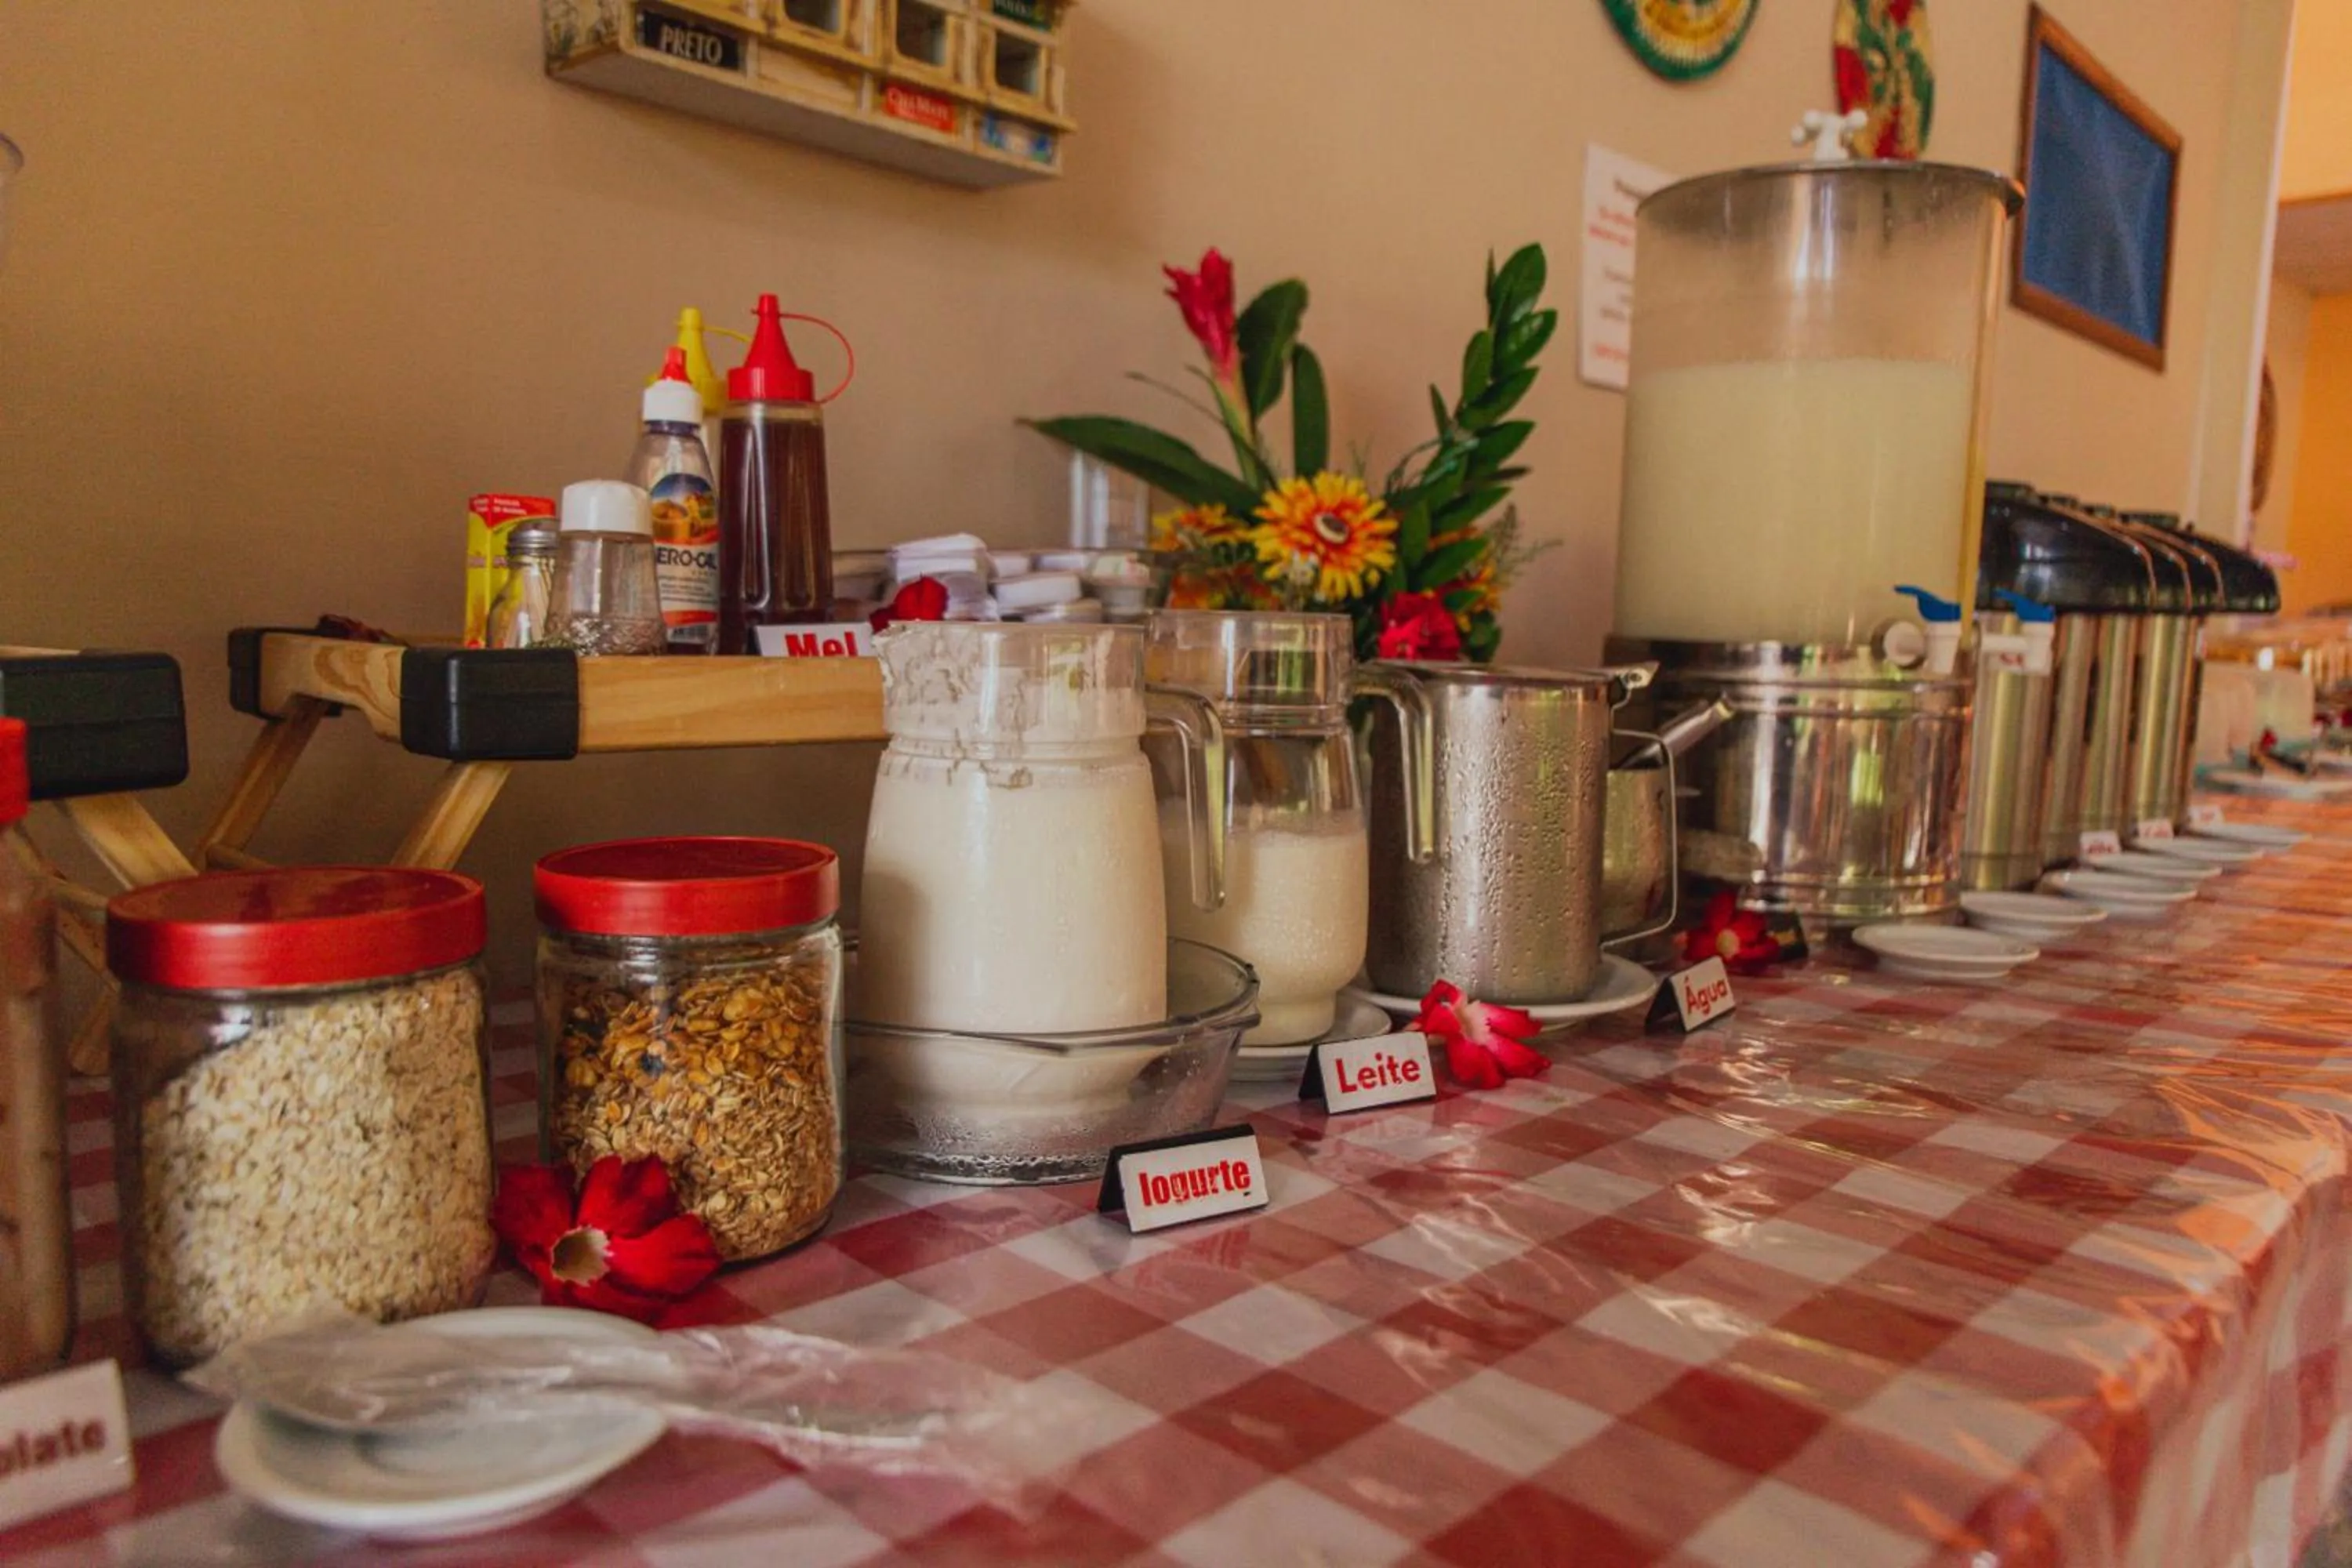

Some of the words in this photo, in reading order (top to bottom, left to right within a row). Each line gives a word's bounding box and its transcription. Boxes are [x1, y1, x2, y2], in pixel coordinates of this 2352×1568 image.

[660, 23, 723, 65] PRETO
[785, 630, 858, 657] Mel
[1684, 975, 1728, 1016] Água
[1335, 1051, 1421, 1094] Leite
[1139, 1159, 1252, 1208] Iogurte
